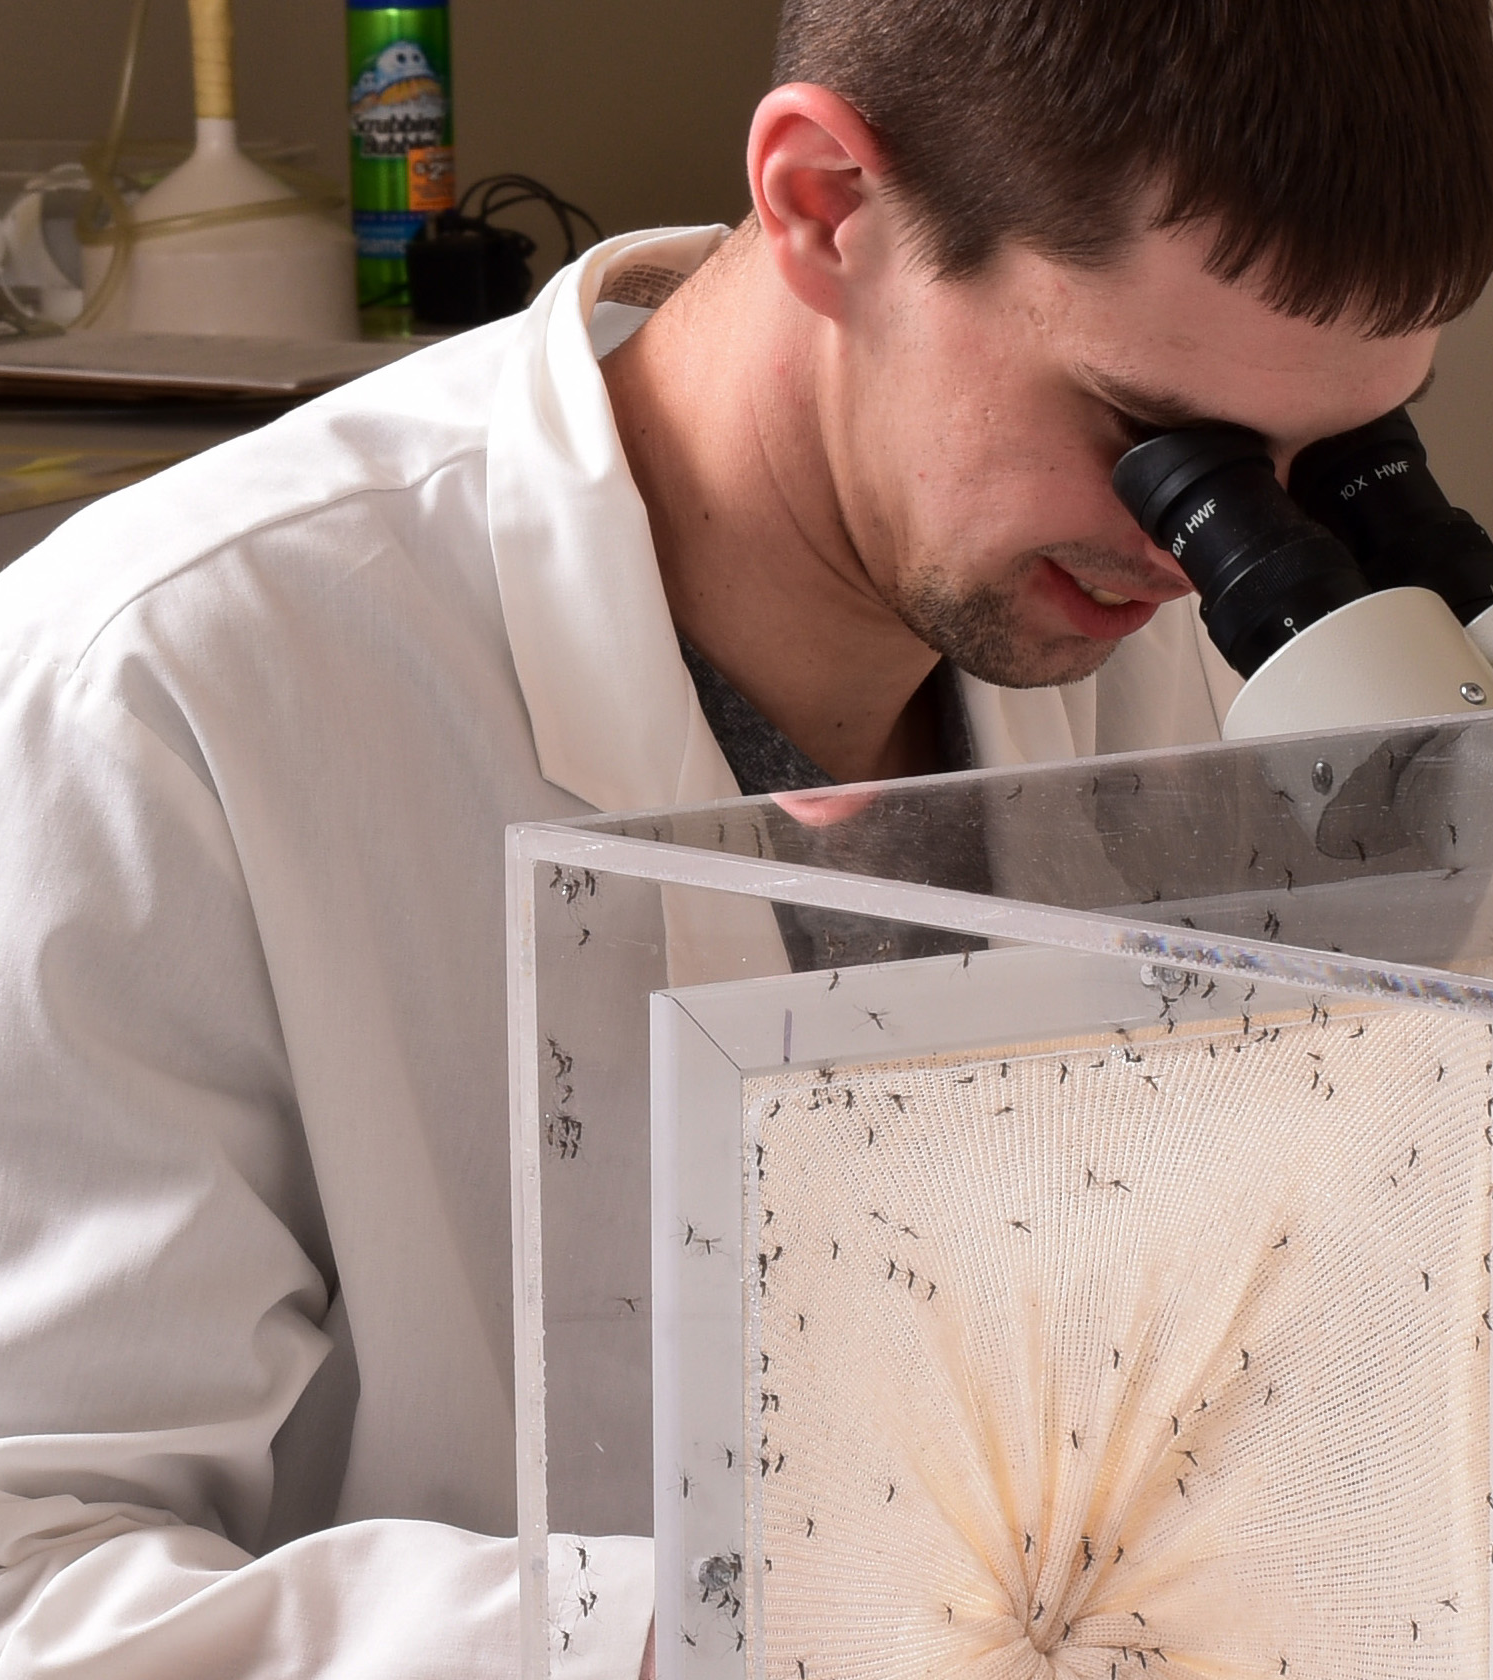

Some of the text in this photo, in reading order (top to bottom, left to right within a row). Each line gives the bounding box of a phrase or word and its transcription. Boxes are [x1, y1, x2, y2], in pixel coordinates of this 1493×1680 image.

[1374, 461, 1410, 480] HWF
[1172, 498, 1217, 559] 0X HWF
